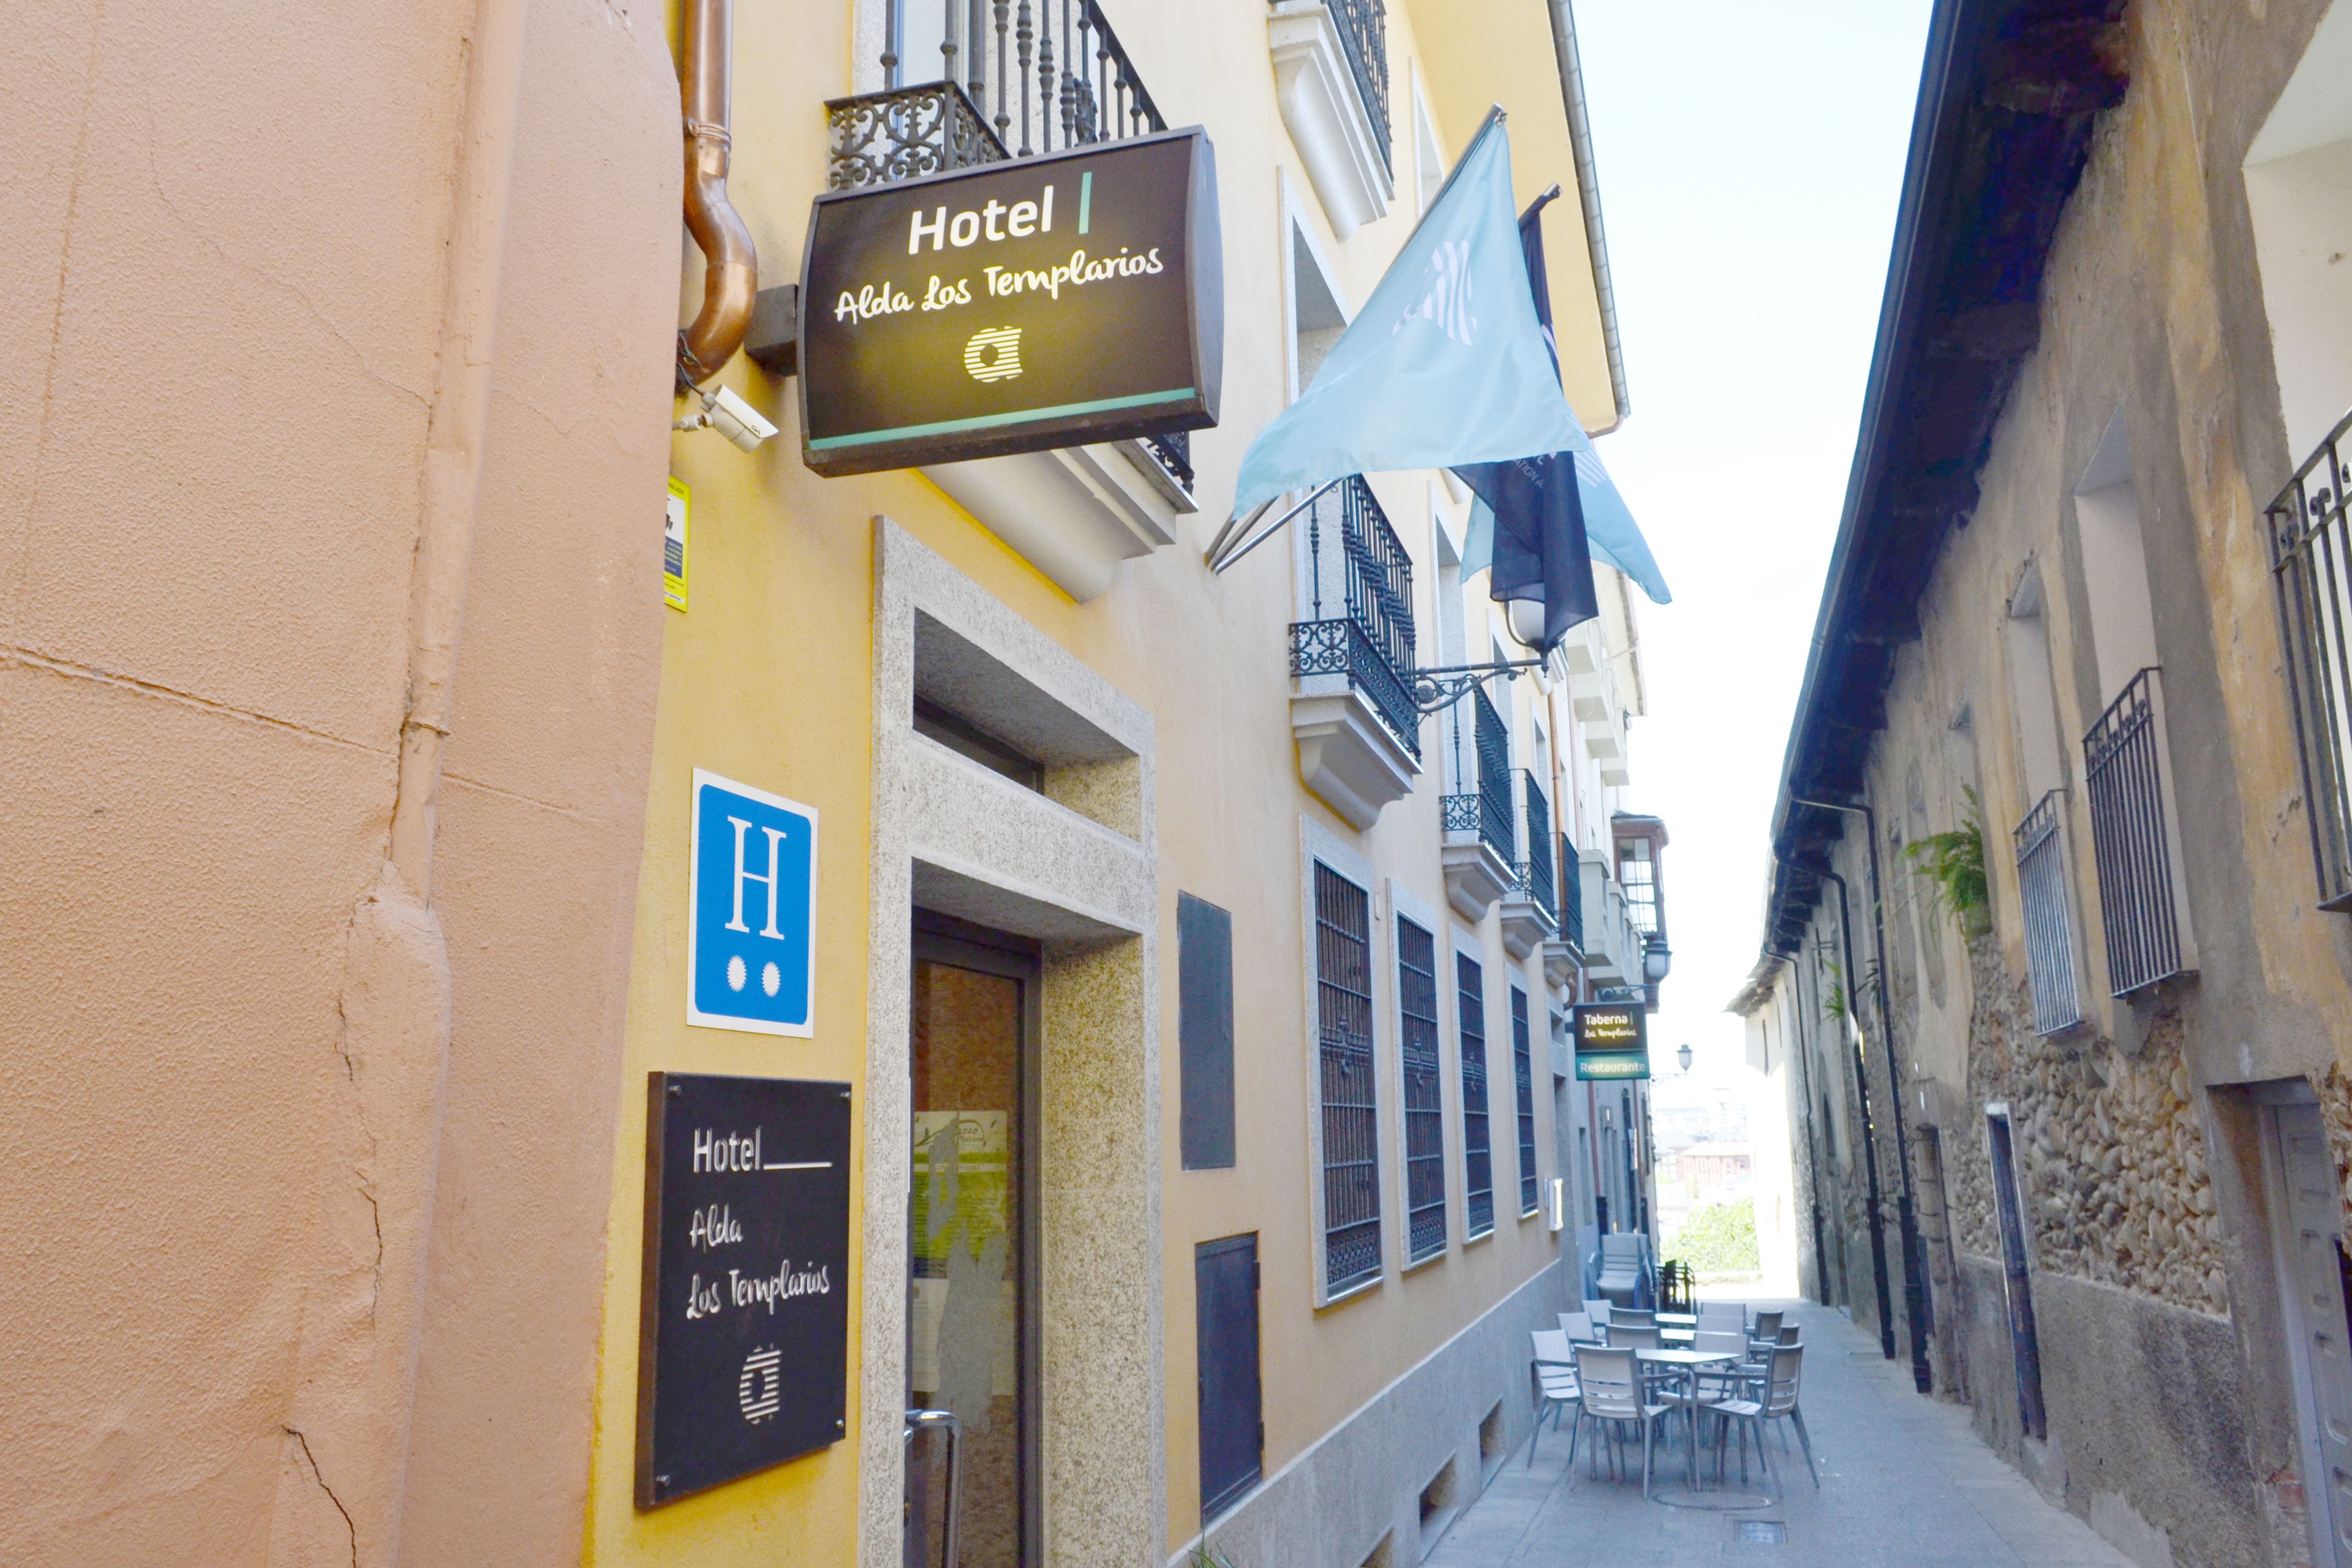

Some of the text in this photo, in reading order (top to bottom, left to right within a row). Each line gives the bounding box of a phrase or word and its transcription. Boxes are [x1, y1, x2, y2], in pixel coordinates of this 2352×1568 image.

[908, 185, 1054, 255] Hotel
[834, 247, 1163, 325] Alda Los Templarios
[725, 816, 787, 940] H
[1584, 1014, 1628, 1025] Taberna
[1597, 1028, 1637, 1039] Templarios
[1580, 1062, 1646, 1073] Restaurante
[692, 1126, 761, 1173] Hotel
[689, 1204, 744, 1254] Alda
[686, 1260, 831, 1319] Los Templarios
